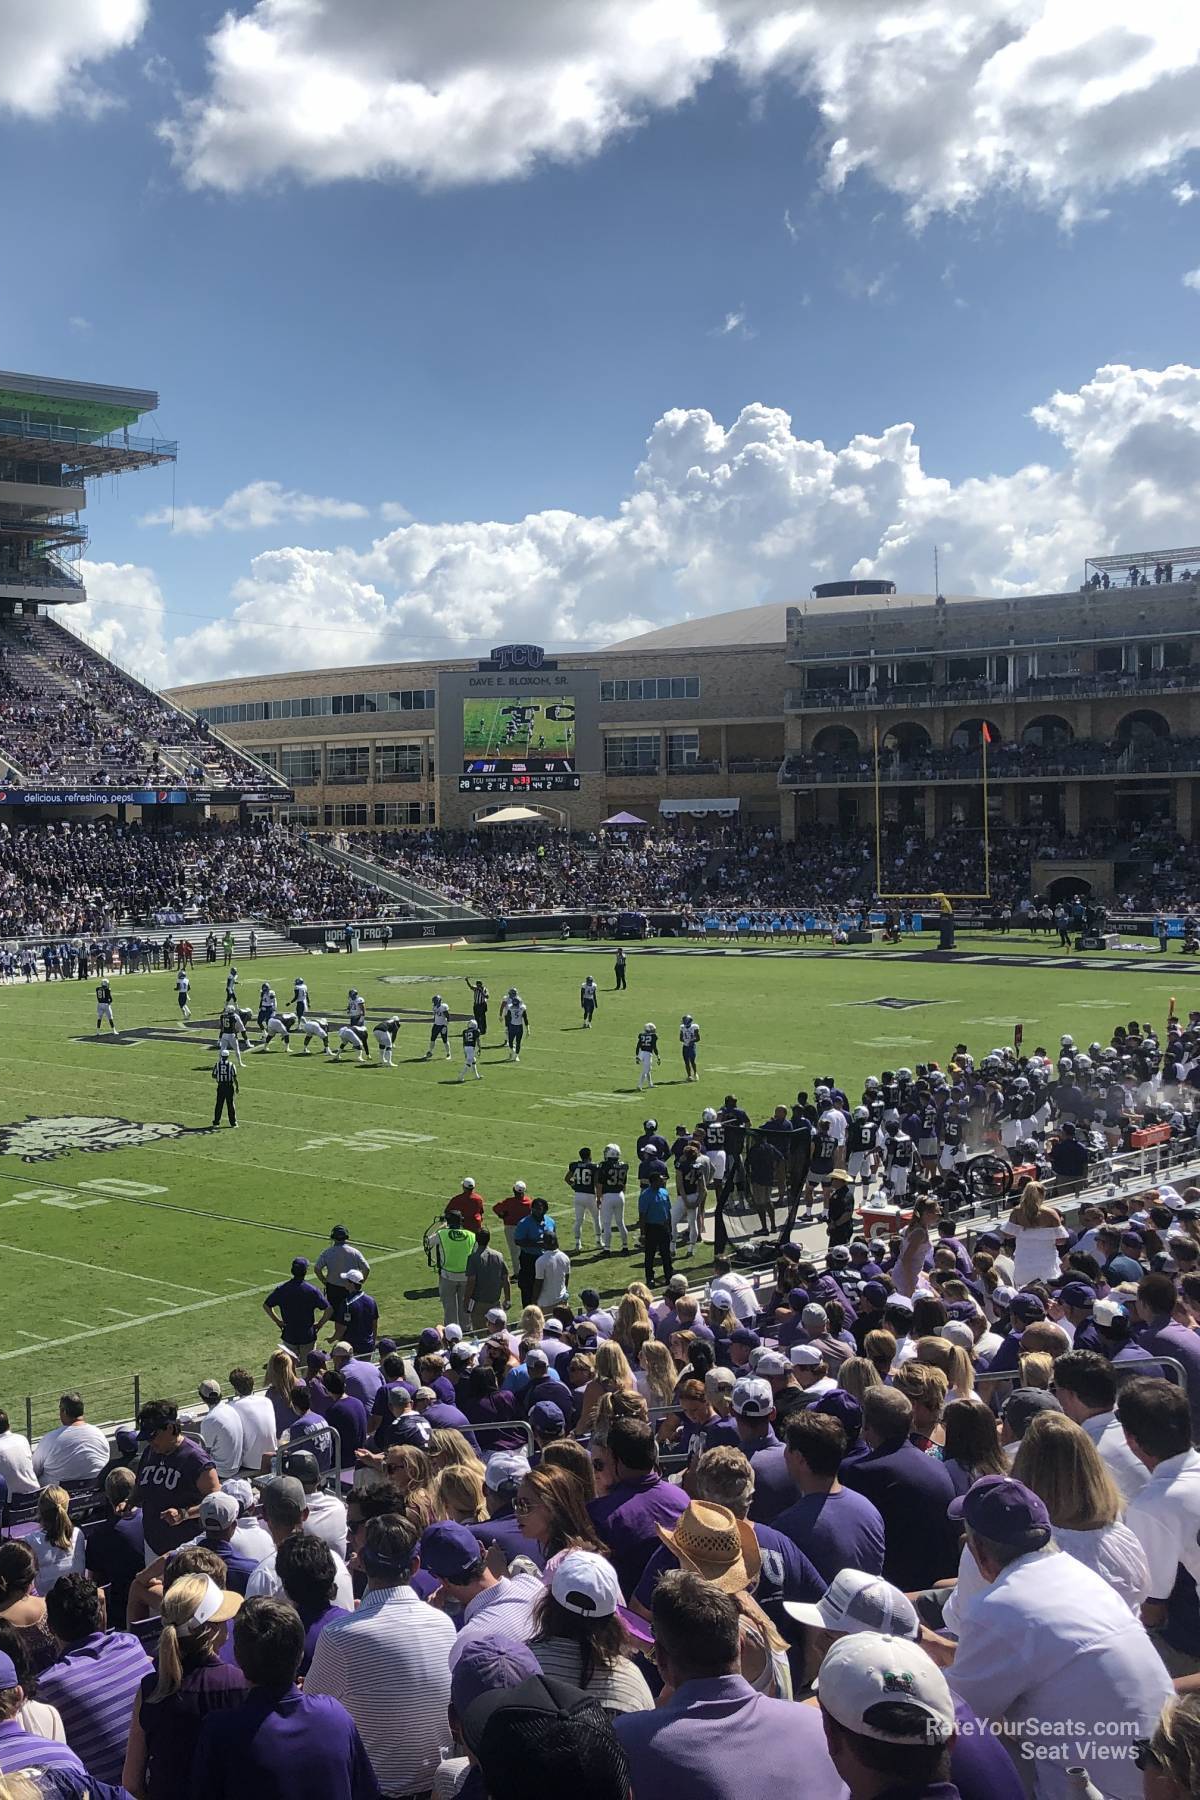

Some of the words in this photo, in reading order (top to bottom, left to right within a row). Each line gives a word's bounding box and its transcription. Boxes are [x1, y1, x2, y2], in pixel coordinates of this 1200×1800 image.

[496, 645, 543, 669] TCU
[470, 678, 494, 686] DAVE
[545, 763, 554, 771] 41
[460, 781, 470, 789] 28
[573, 778, 579, 787] 0
[24, 792, 62, 803] delicious.
[64, 792, 108, 804] refreshing.
[220, 1065, 228, 1075] R
[307, 1129, 439, 1152] 30
[707, 1127, 725, 1144] 55
[861, 1128, 871, 1144] 9
[572, 1168, 592, 1186] 46
[607, 1168, 625, 1186] 39
[12, 1177, 170, 1210] 20
[870, 1221, 891, 1243] G
[140, 1466, 182, 1491] TCU
